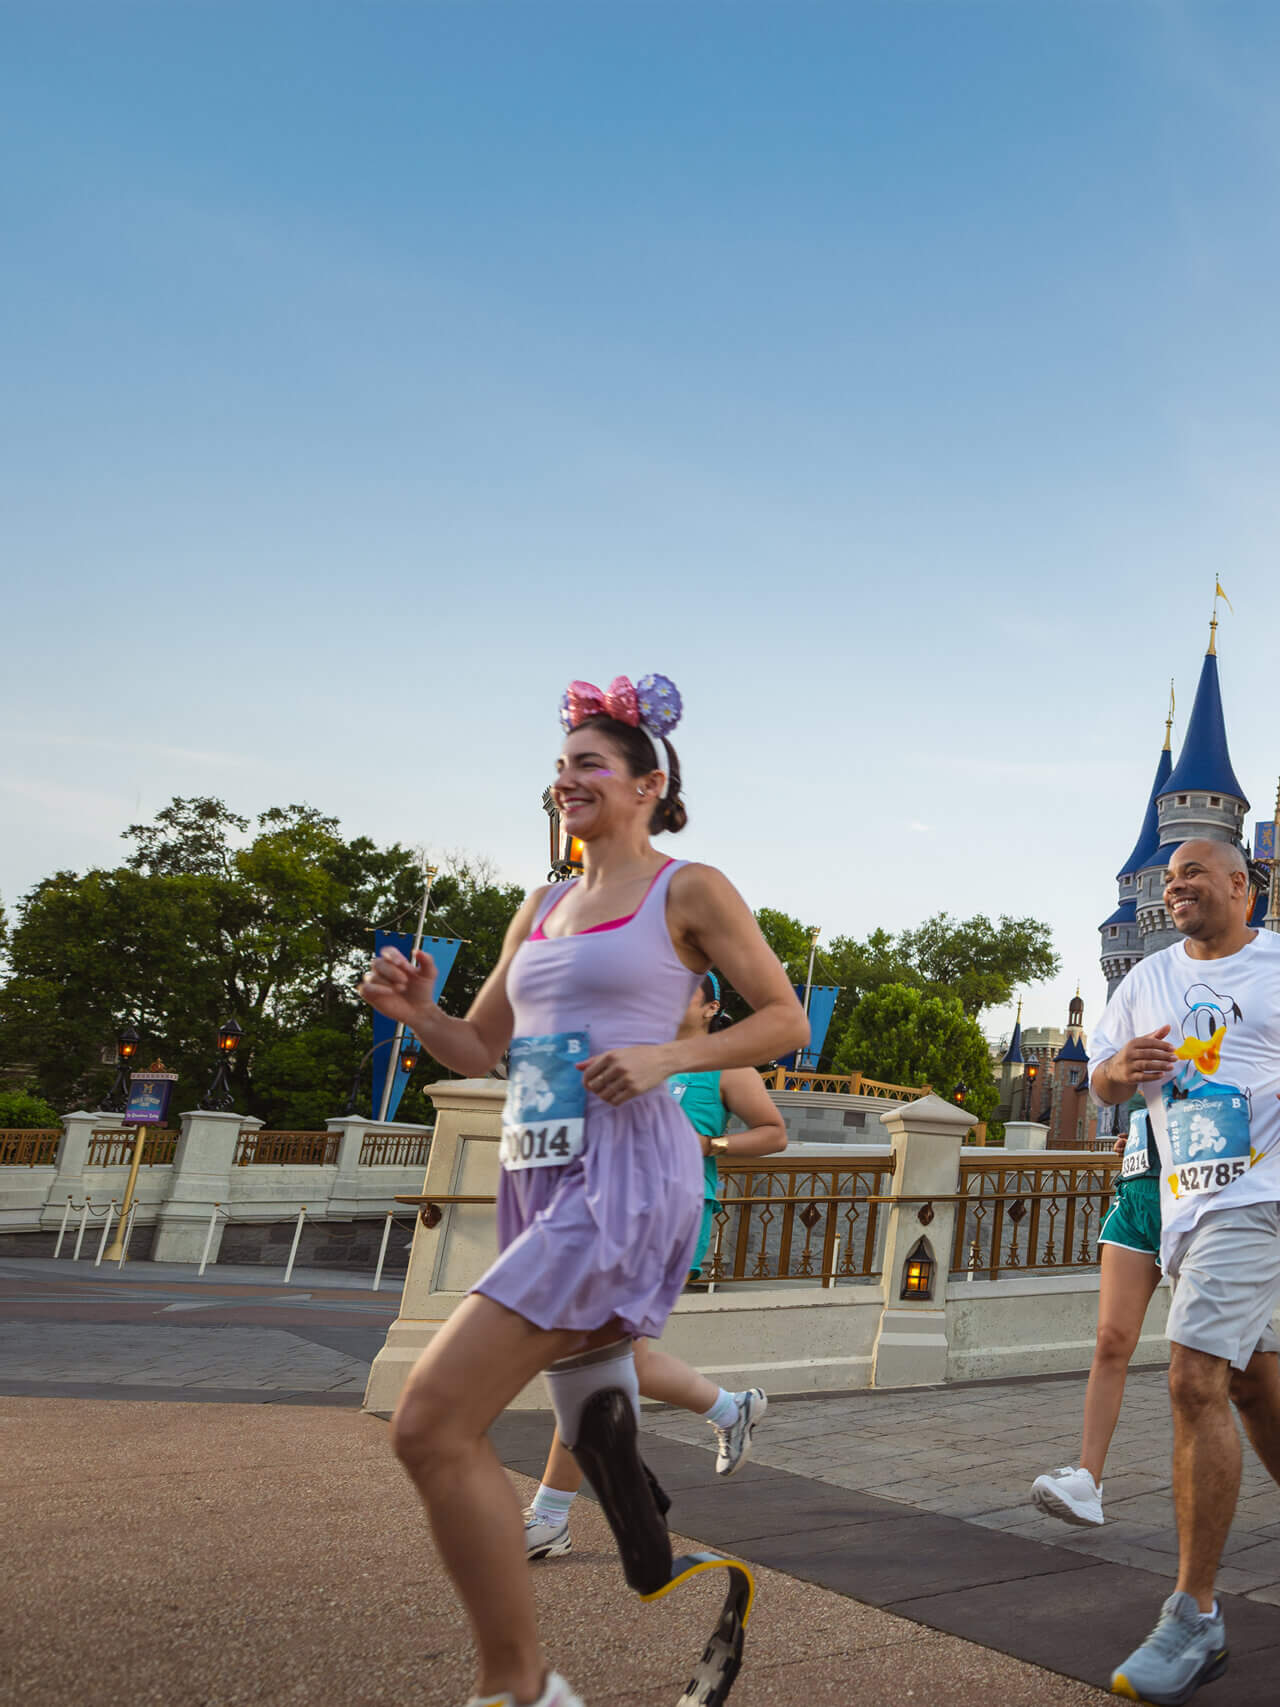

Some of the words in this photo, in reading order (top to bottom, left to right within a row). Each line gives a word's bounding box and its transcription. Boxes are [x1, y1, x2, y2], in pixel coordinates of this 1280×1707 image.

[568, 1040, 581, 1053] B
[1232, 1098, 1241, 1108] B
[1180, 1162, 1245, 1190] 42785
